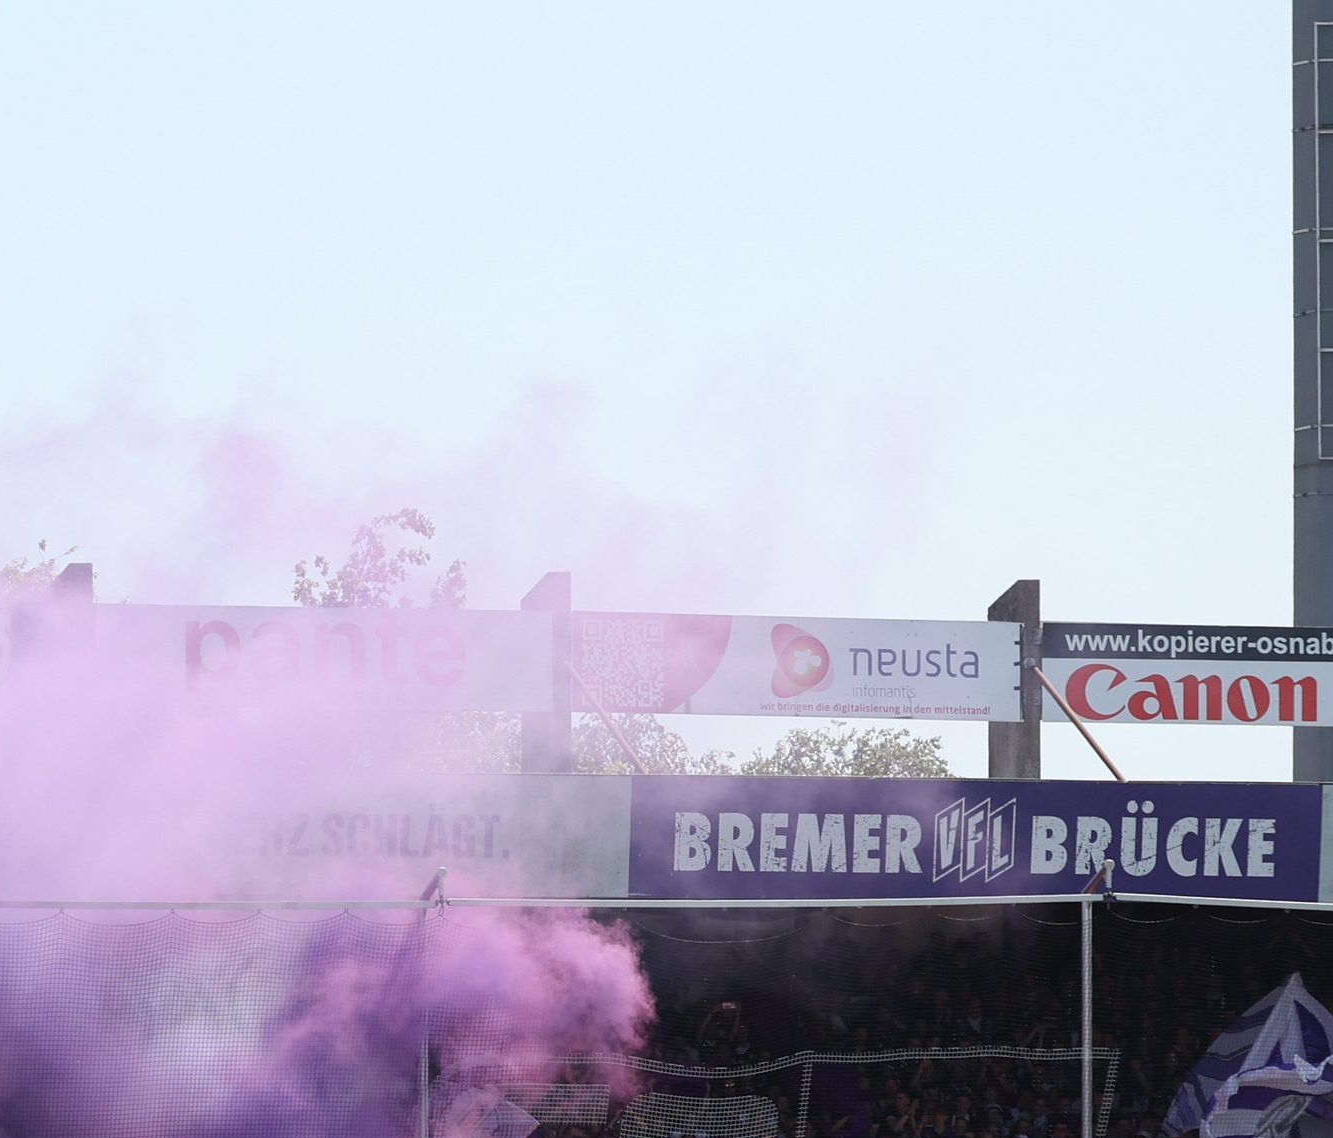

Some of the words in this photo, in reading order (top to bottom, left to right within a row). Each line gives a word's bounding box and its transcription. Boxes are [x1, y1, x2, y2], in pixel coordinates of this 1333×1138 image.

[848, 643, 980, 679] neusta
[1065, 629, 1333, 658] www.kopierer-osnab
[760, 702, 776, 712] wir
[778, 702, 814, 714] bringen
[816, 702, 831, 712] die
[833, 703, 901, 715] digitalisierung
[903, 704, 913, 714] in
[914, 705, 933, 715] den
[934, 705, 991, 716] mittelstand!
[852, 684, 916, 698] infomantis
[1065, 663, 1318, 723] Canon
[321, 800, 510, 860] SCHLÄGT.
[674, 812, 923, 876] BREMER
[1029, 801, 1276, 878] BRÜCKE
